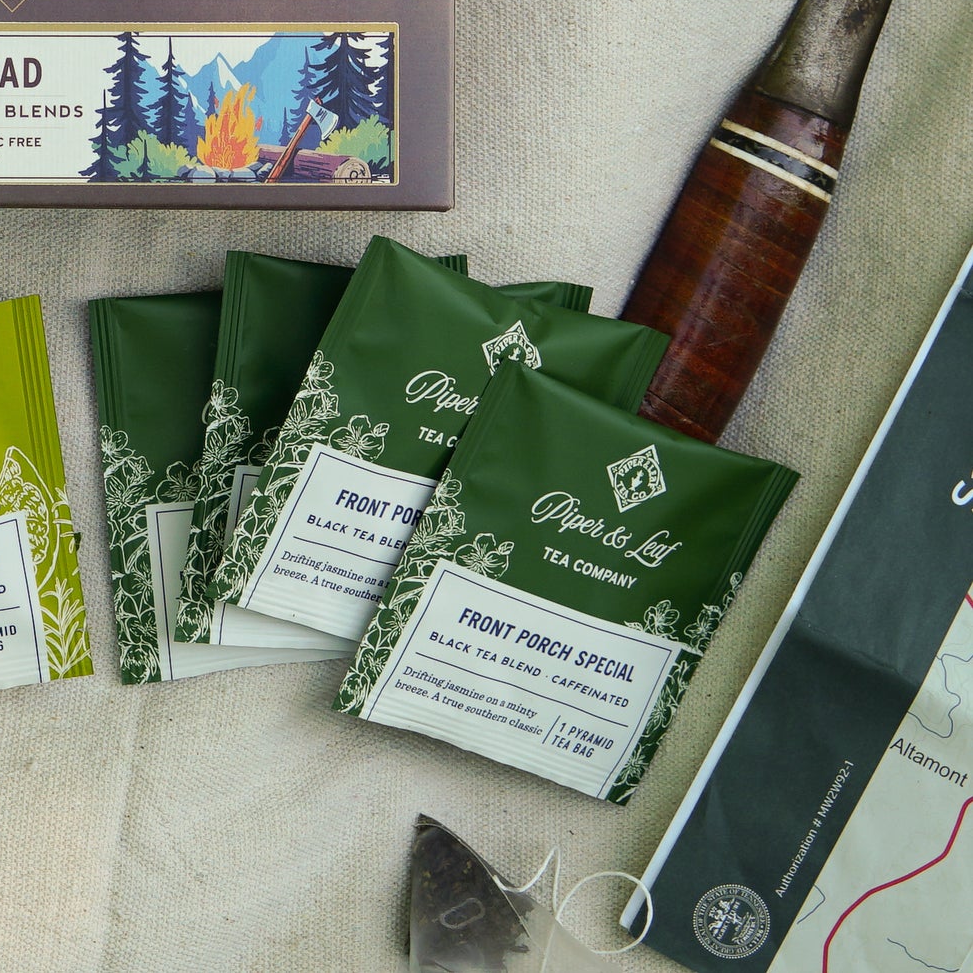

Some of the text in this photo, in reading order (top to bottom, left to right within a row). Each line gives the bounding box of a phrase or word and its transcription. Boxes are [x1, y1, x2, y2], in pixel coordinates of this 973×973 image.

[5, 105, 84, 118] BLENDS
[9, 137, 42, 148] FREE
[531, 491, 682, 568] Piper & Leaf
[543, 547, 637, 589] TEA COMPANY
[430, 632, 629, 708] BLACK TEA BLEND CAFFEINATED
[459, 608, 634, 683] FRONT PORCH SPECIAL
[394, 679, 542, 736] breeze. A true southern classic
[403, 666, 445, 690] Drifting
[442, 681, 485, 704] jasmine
[486, 694, 498, 704] on
[507, 700, 538, 719] minty
[890, 738, 969, 788] Altamont
[775, 759, 855, 898] Authorization # MW2W92-1
